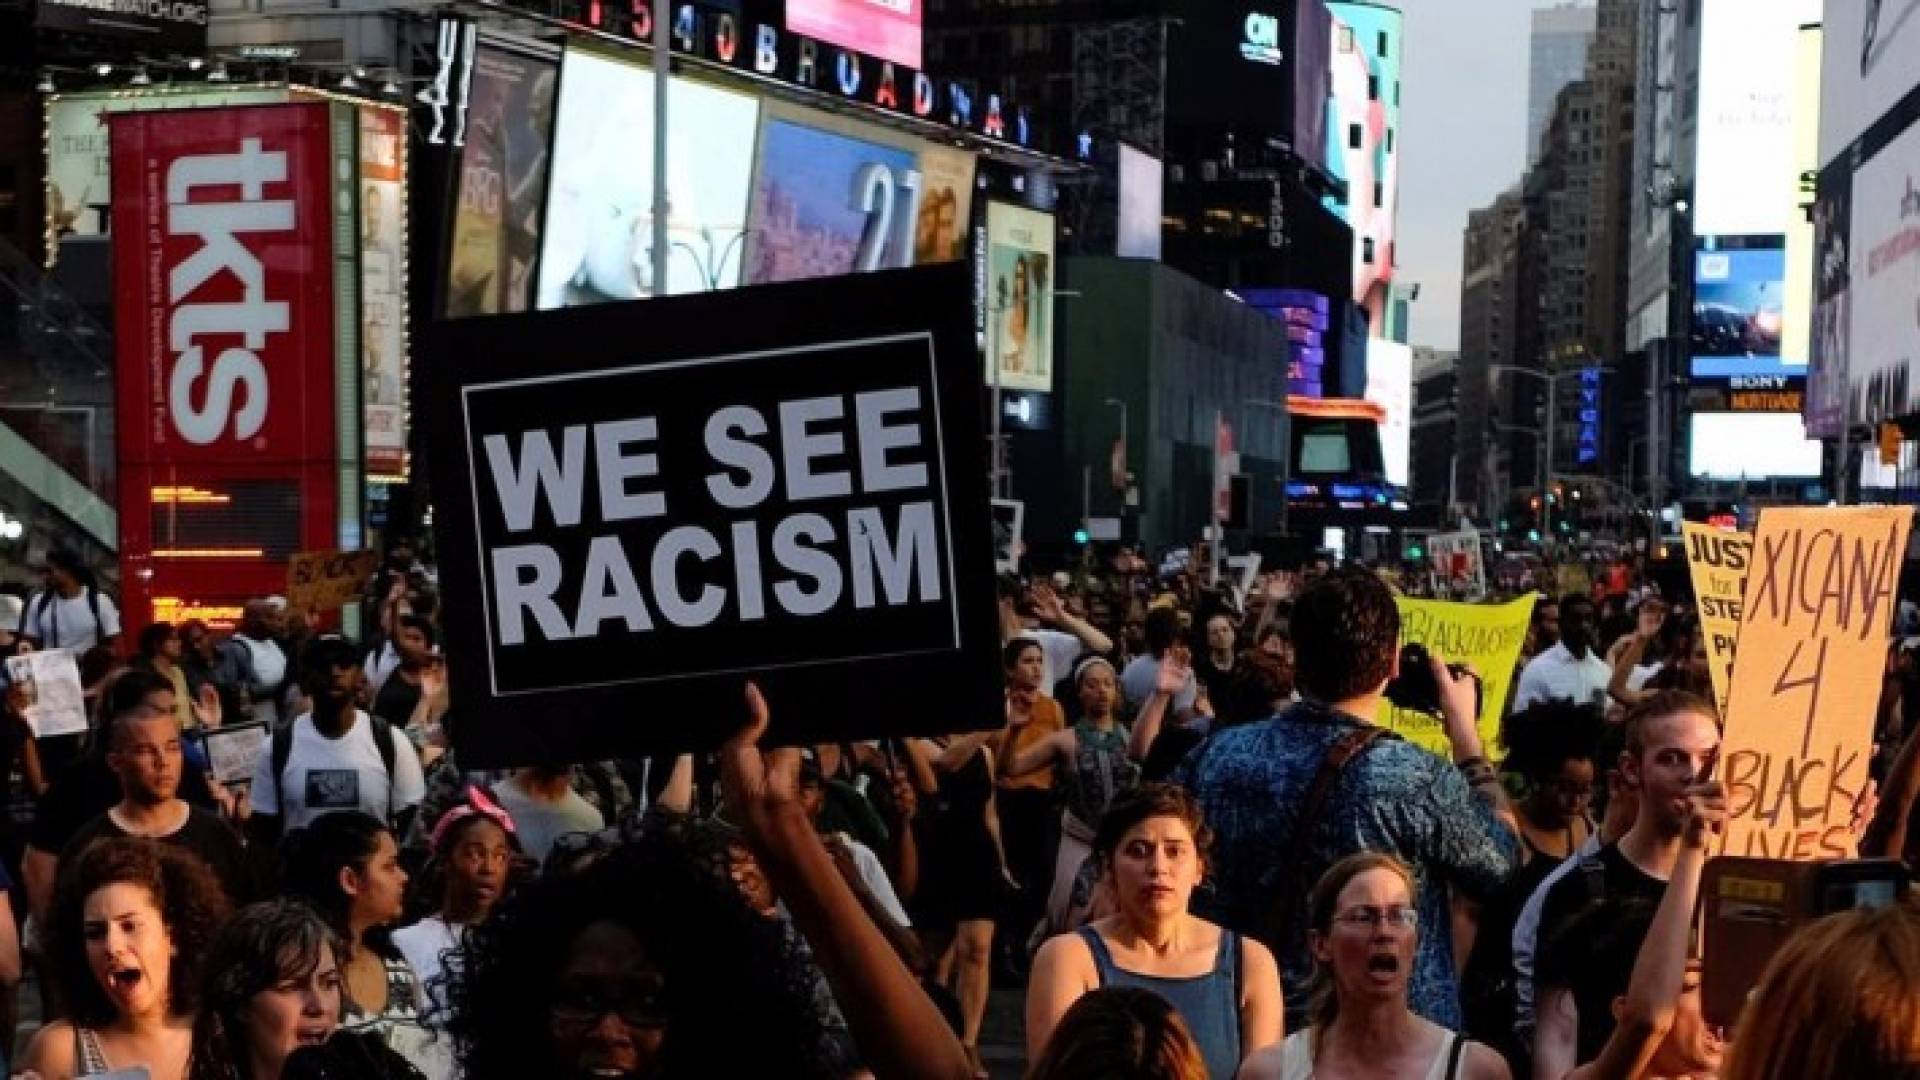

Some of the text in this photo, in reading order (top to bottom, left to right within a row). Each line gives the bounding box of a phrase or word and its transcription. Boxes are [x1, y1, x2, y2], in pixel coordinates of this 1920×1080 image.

[756, 24, 1030, 146] BROADWAY
[150, 248, 163, 305] Theatre
[168, 136, 295, 444] tkts
[149, 308, 165, 404] Development
[1729, 375, 1788, 389] SONY
[152, 407, 166, 444] Fund
[483, 385, 930, 532] WE SEE
[491, 500, 941, 647] RACISM
[1748, 517, 1899, 641] XICANA
[1771, 636, 1828, 759] 4
[1725, 745, 1861, 828] BLACK
